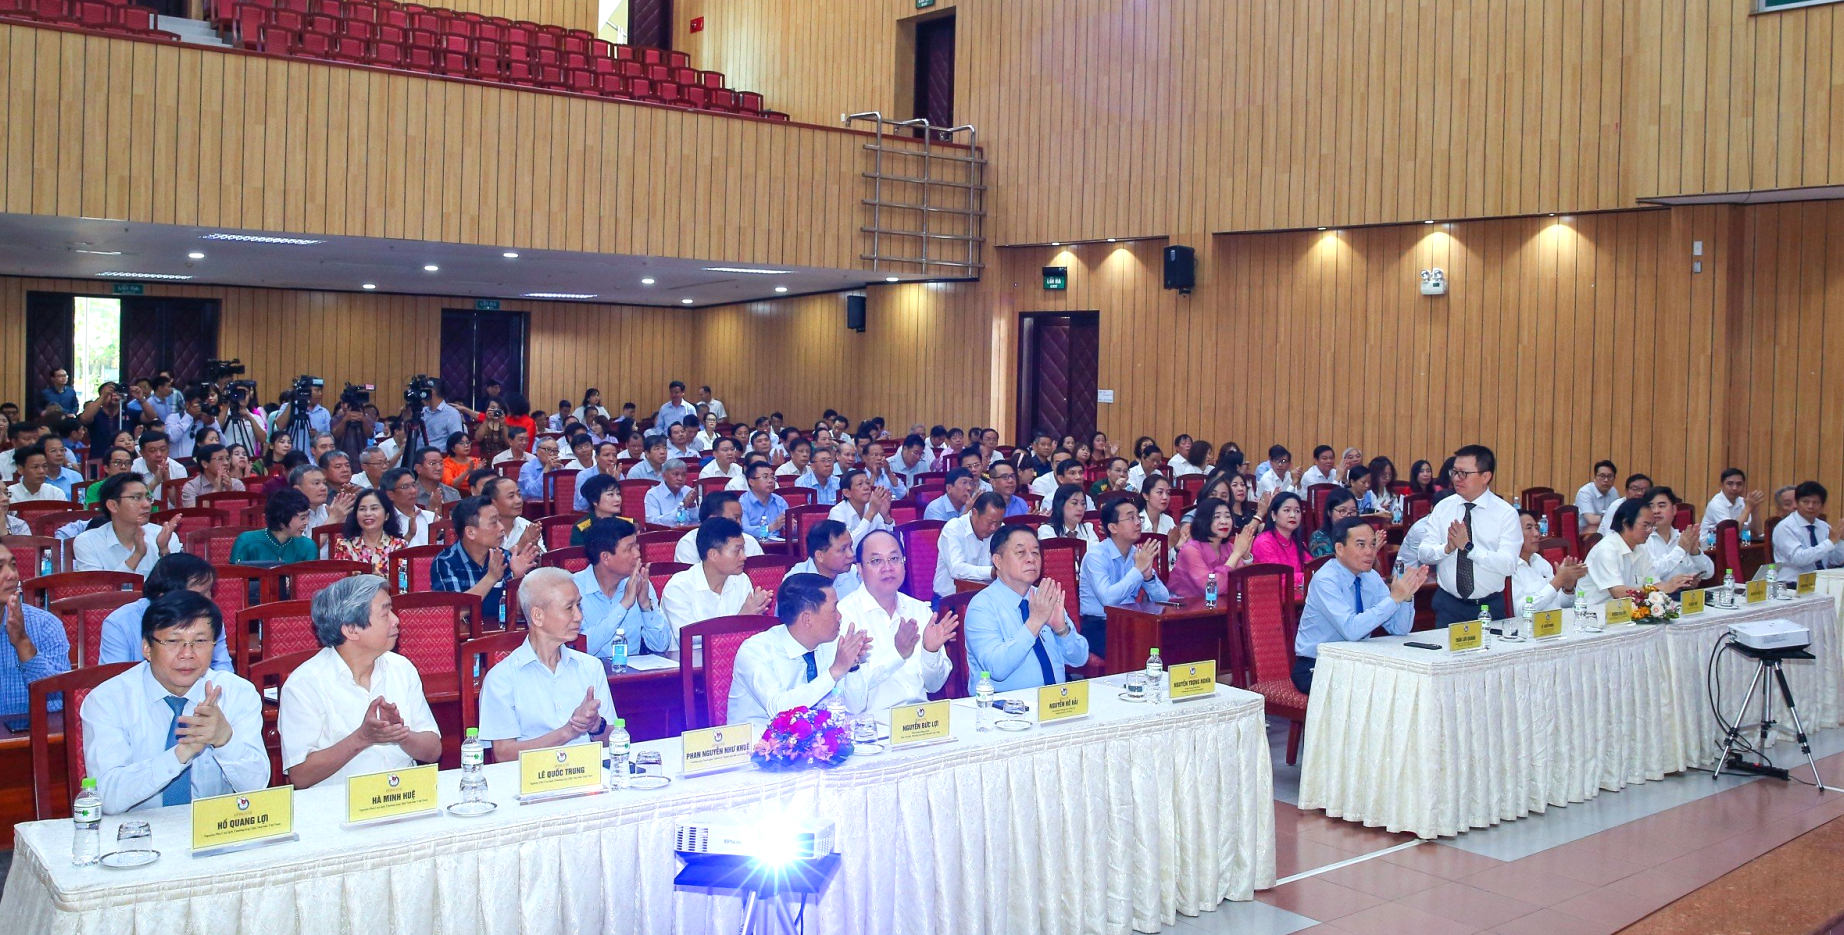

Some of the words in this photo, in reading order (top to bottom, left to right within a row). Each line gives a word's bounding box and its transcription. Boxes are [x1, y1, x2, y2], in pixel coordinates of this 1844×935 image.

[686, 751, 701, 760] PHAN
[538, 770, 545, 779] LÊ
[547, 767, 564, 778] QUỐC
[566, 766, 585, 775] TRUNG
[372, 795, 381, 804] HÀ
[383, 793, 401, 803] MINH
[403, 789, 416, 800] HUỆ
[230, 816, 255, 828] QUANG
[257, 814, 269, 824] LỢI
